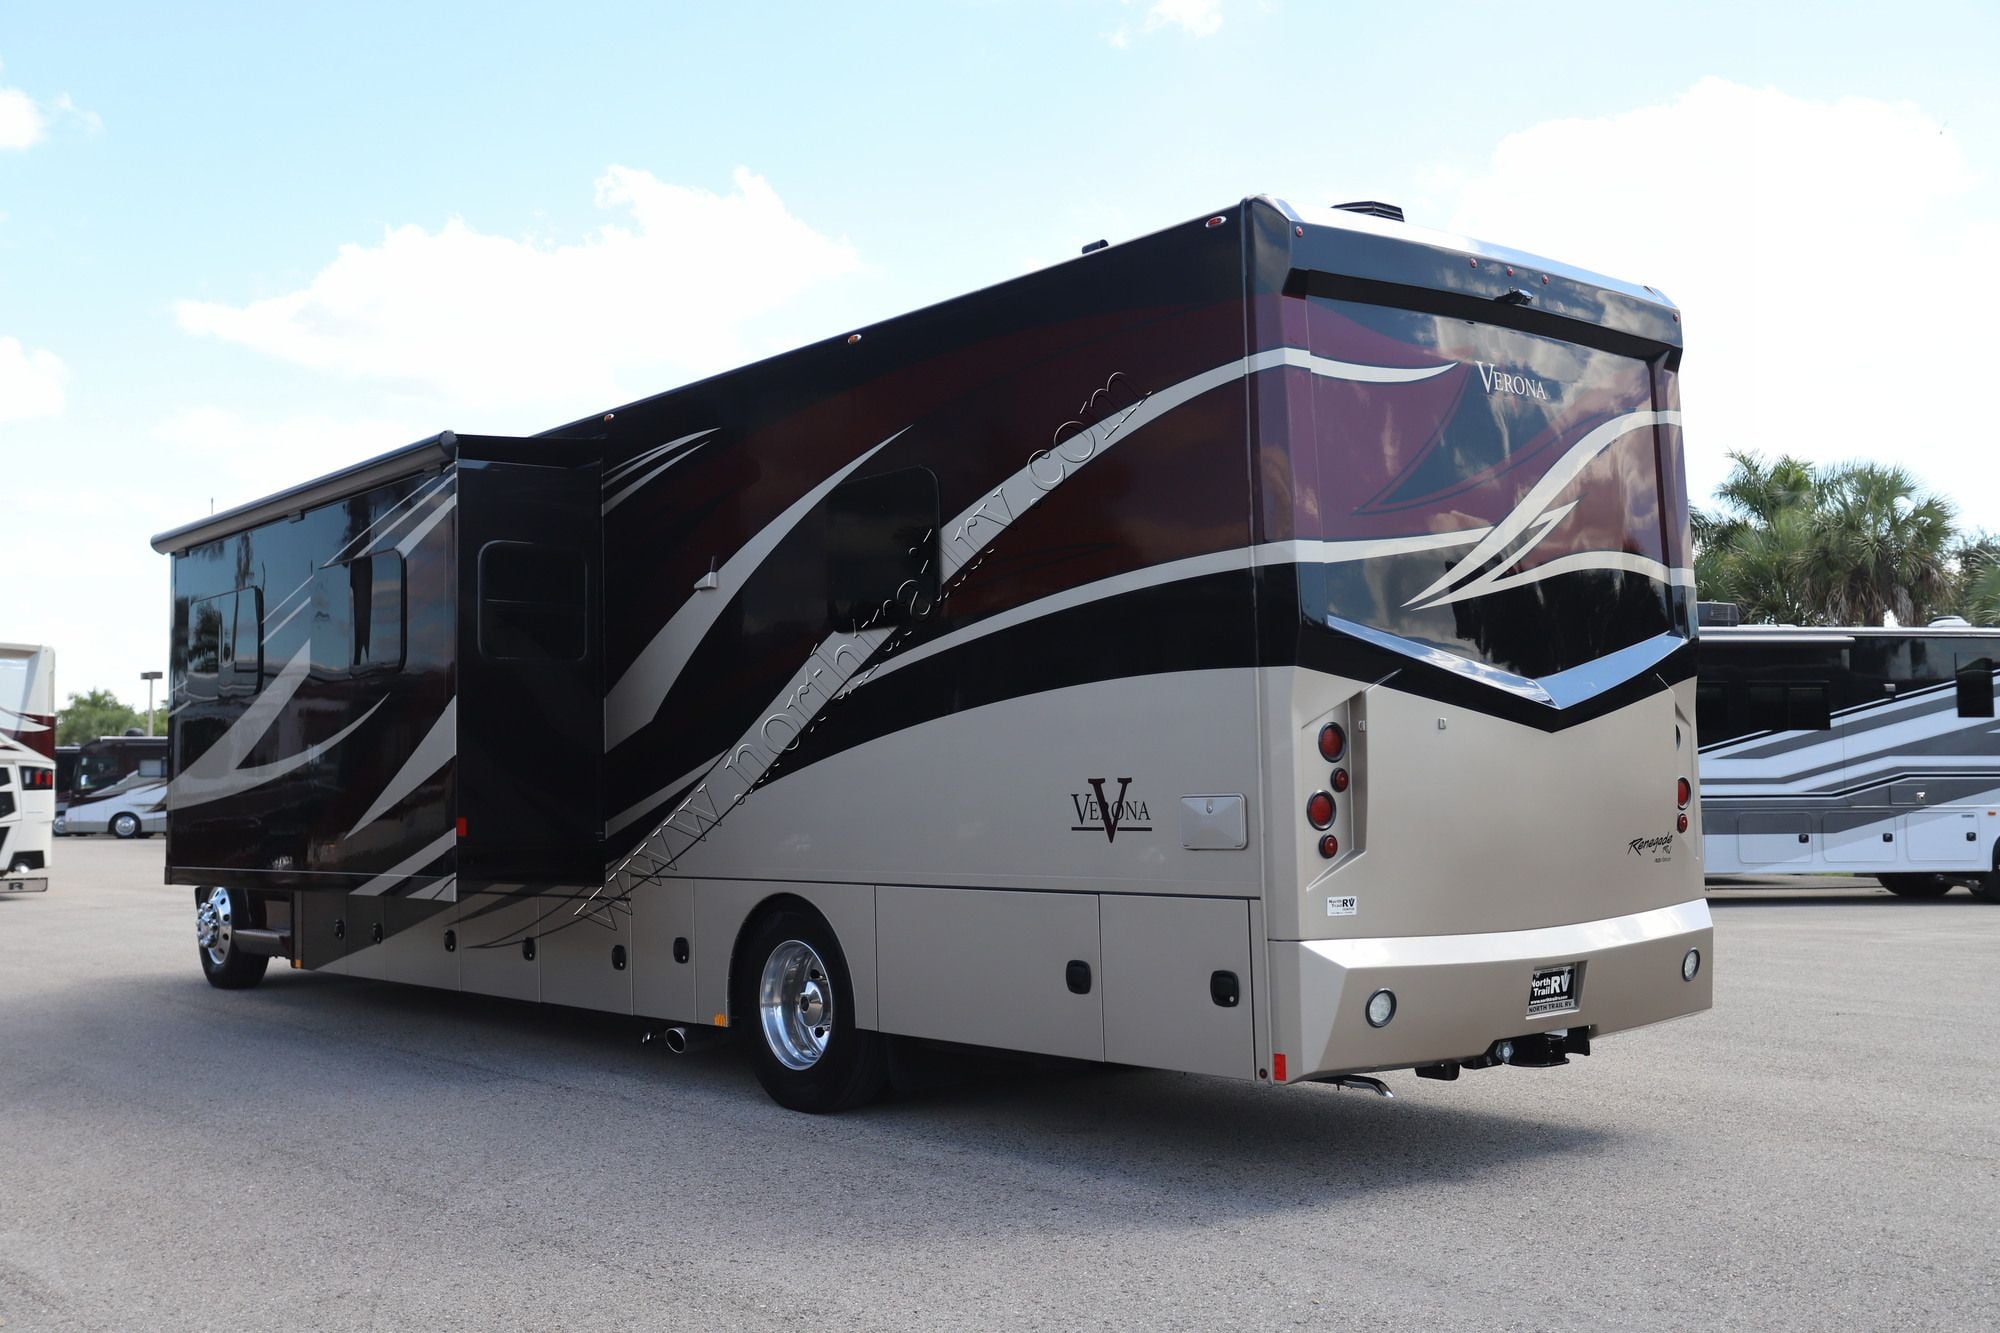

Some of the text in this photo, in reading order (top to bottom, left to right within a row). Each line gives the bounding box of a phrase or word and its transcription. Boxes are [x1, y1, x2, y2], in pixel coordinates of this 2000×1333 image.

[1475, 360, 1547, 400] VERONA
[1628, 832, 1672, 856] Renegade
[1342, 898, 1355, 907] RV
[1533, 986, 1550, 996] Trail
[1551, 974, 1570, 994] RV
